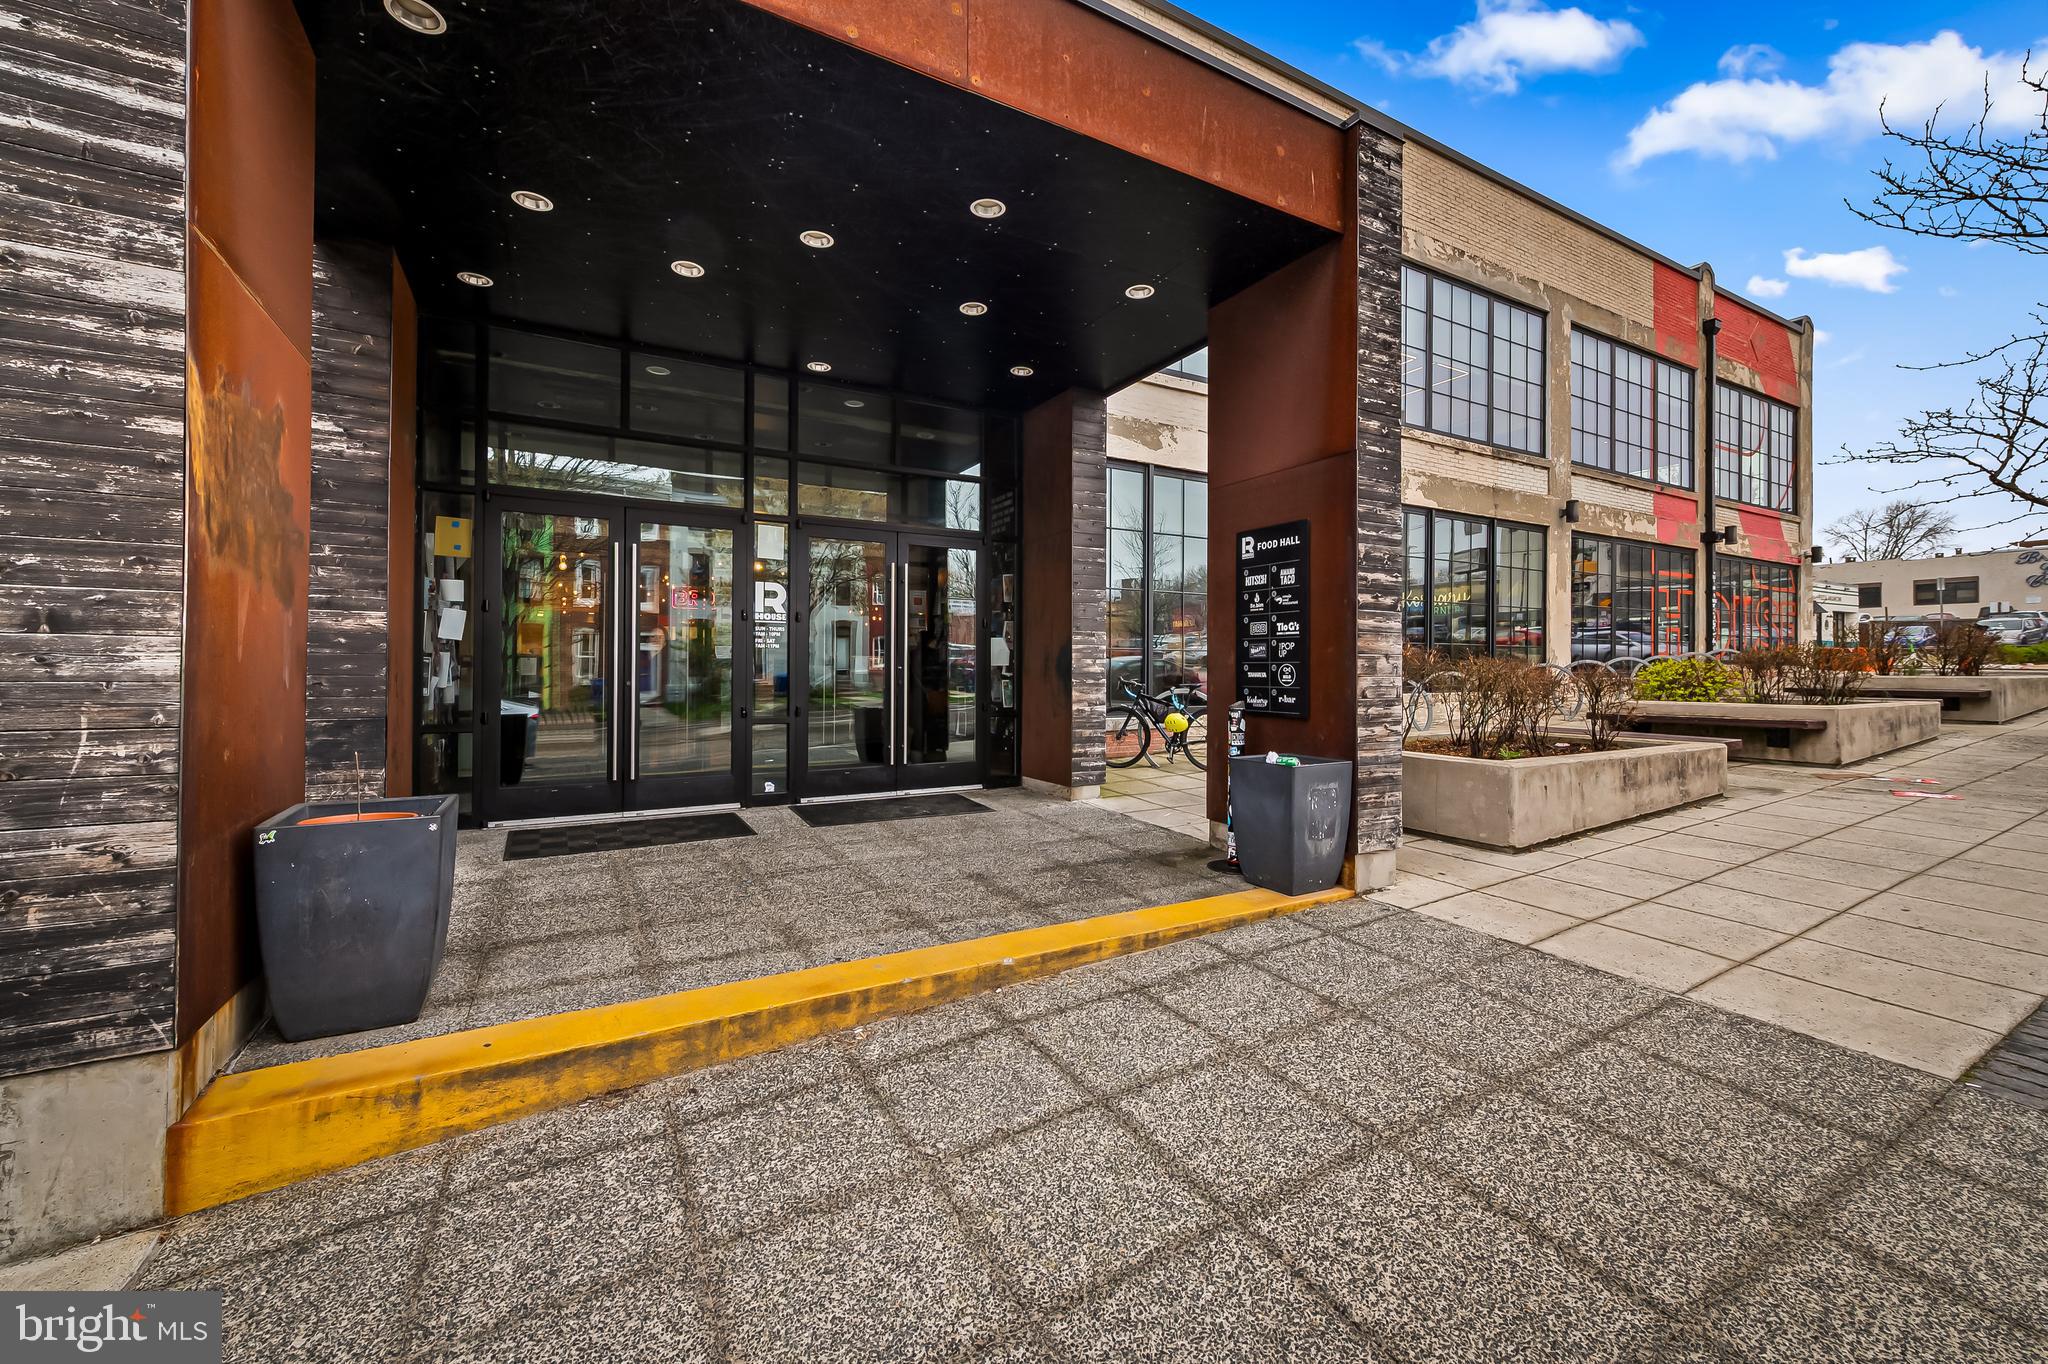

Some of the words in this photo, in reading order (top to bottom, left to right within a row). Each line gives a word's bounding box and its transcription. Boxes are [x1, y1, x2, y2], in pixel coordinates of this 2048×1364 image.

[1241, 536, 1255, 554] R
[1257, 539, 1278, 551] FOOD
[1279, 535, 1301, 547] HALL
[1280, 574, 1296, 586] TACO
[754, 581, 788, 614] R
[754, 612, 788, 621] HOUSE
[1281, 642, 1296, 650] POP
